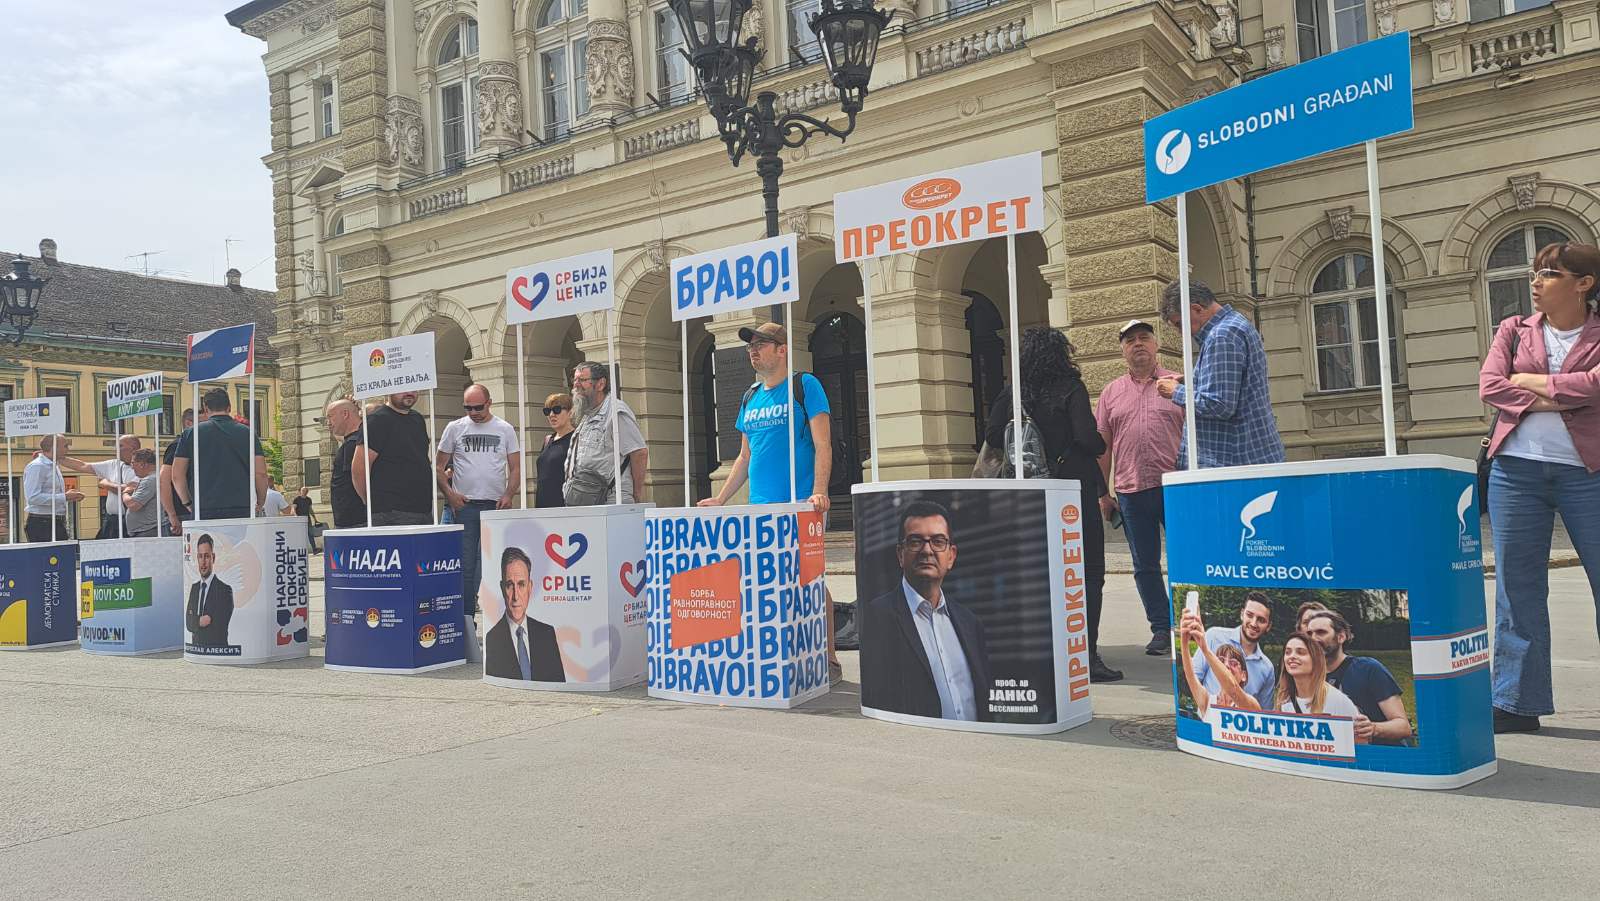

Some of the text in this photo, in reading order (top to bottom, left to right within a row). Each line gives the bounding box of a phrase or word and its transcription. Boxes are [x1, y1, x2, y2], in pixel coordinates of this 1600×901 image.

[1197, 73, 1393, 149] SLOBODNI GRAĐANI
[843, 196, 1031, 260] ПРЕОКРЕТ
[555, 265, 607, 285] СРБИЈА
[677, 246, 790, 310] БРАВО!
[556, 281, 607, 302] ЦЕНТАР
[356, 372, 430, 393] БЕЗ КРАЉА НЕ ВАЉА
[744, 404, 788, 423] BRAVO!
[662, 516, 750, 551] BRAVO!
[275, 531, 286, 608] НАРОДНИ
[349, 549, 402, 572] НАДА
[433, 558, 461, 572] НАДА
[1206, 562, 1334, 580] PAVLE GRBOVIĆ
[1451, 560, 1467, 571] PAVLE
[85, 564, 120, 580] Nova Liga
[287, 546, 298, 607] ПОКРЕТ
[298, 548, 308, 606] СРБИЈЕ
[52, 572, 60, 606] СТРАНКА
[93, 588, 112, 601] NOVI
[113, 587, 134, 601] SAD
[543, 575, 592, 592] СРЦЕ
[690, 589, 715, 598] БОРБА
[44, 573, 52, 629] ДЕМОКРАТСКА
[623, 600, 648, 613] СРБИЈА
[673, 599, 736, 609] РАВНОПРАВНОСТ
[758, 580, 825, 624] БРАВО!
[677, 609, 732, 620] ОДГОВОРНОСТ
[1062, 528, 1089, 702] ПРЕОКРЕТ
[759, 614, 827, 660] BRAVO!
[205, 646, 240, 654] АЛЕКСИЋ
[665, 658, 755, 698] BRAVO!
[761, 651, 828, 698] БРАВО!
[995, 679, 1018, 687] проф.
[989, 689, 1037, 701] ЈАНКО
[1220, 711, 1335, 741] POLITIKA
[1221, 731, 1335, 753] KAKVA TREBA DA BUDE
